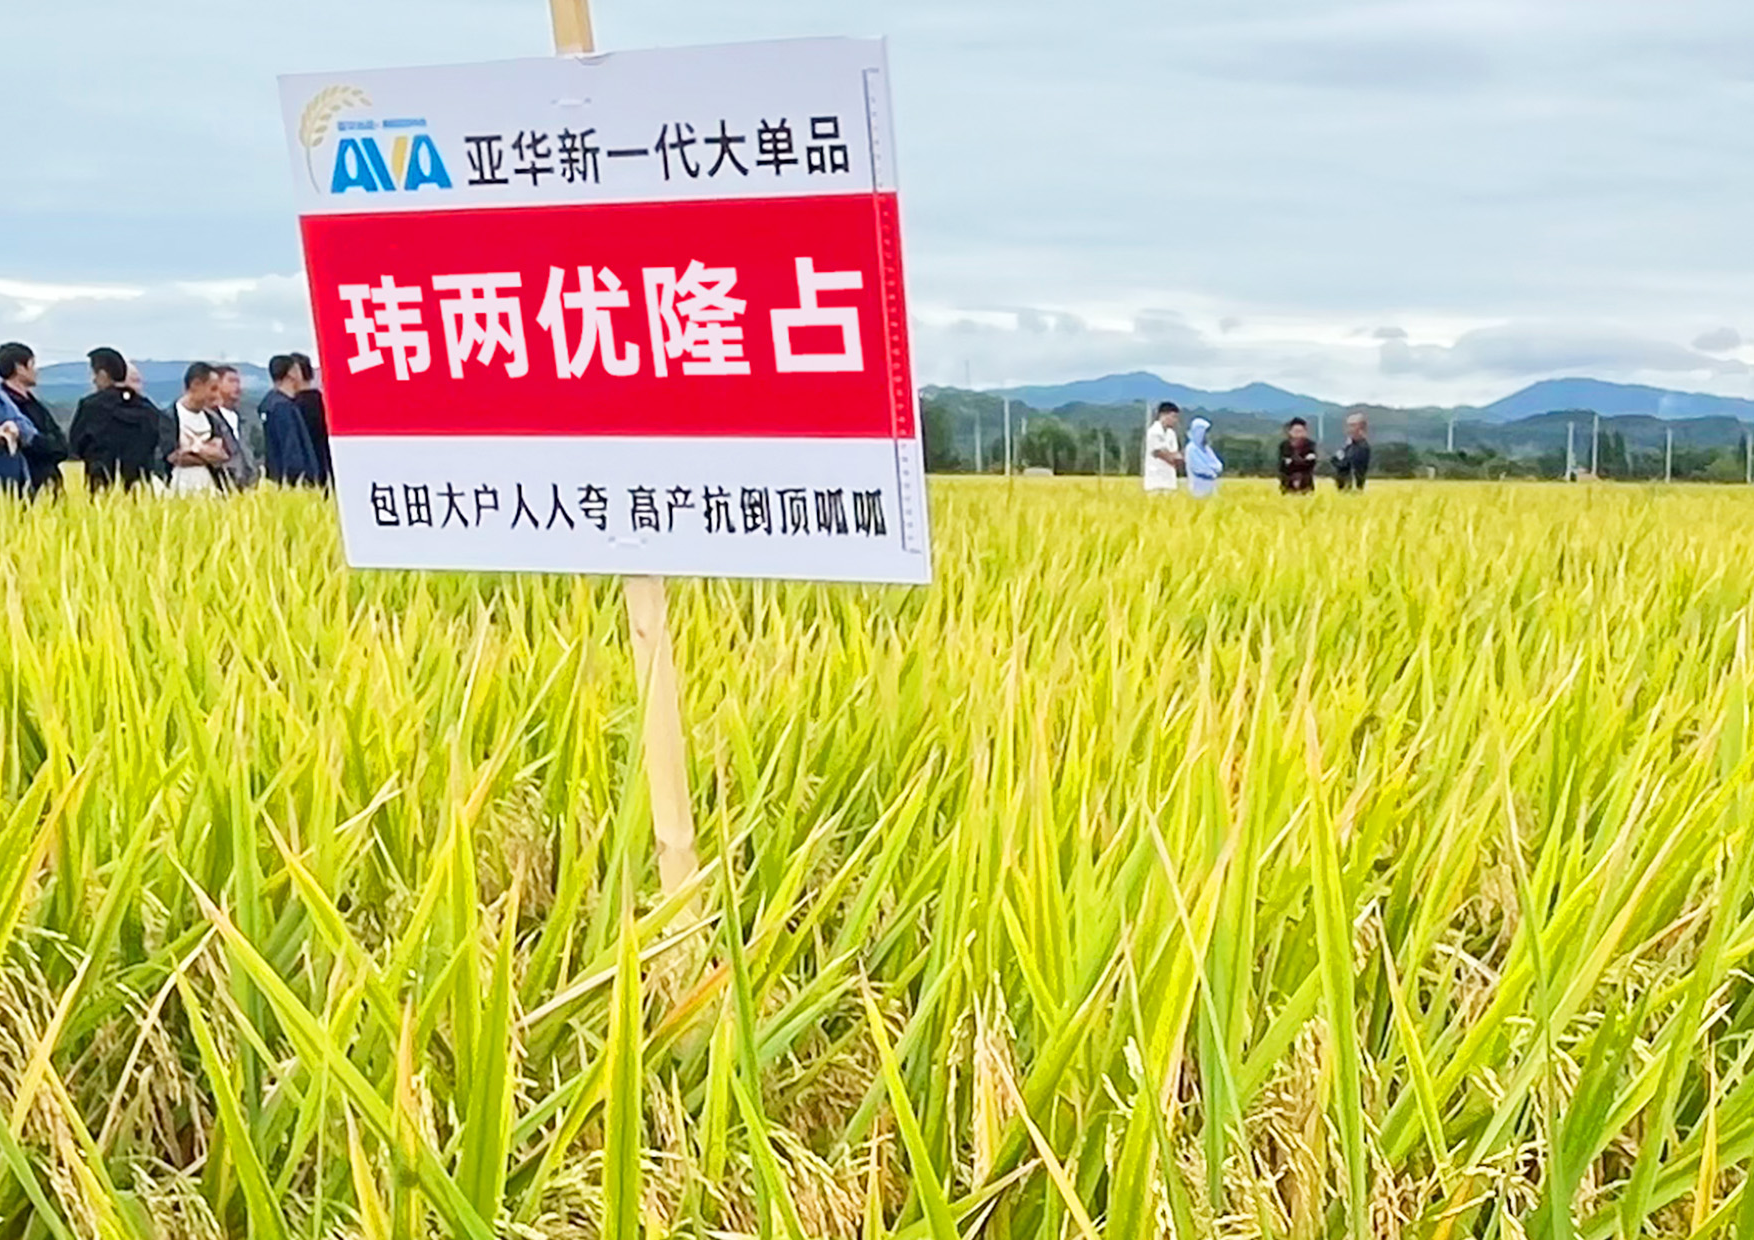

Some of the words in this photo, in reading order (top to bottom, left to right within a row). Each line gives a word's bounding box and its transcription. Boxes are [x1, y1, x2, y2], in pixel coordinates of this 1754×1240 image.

[464, 116, 849, 186] 亚华新一代大单品
[339, 257, 865, 381] 玮两优隆占
[371, 482, 608, 531] 包田大户人人夸
